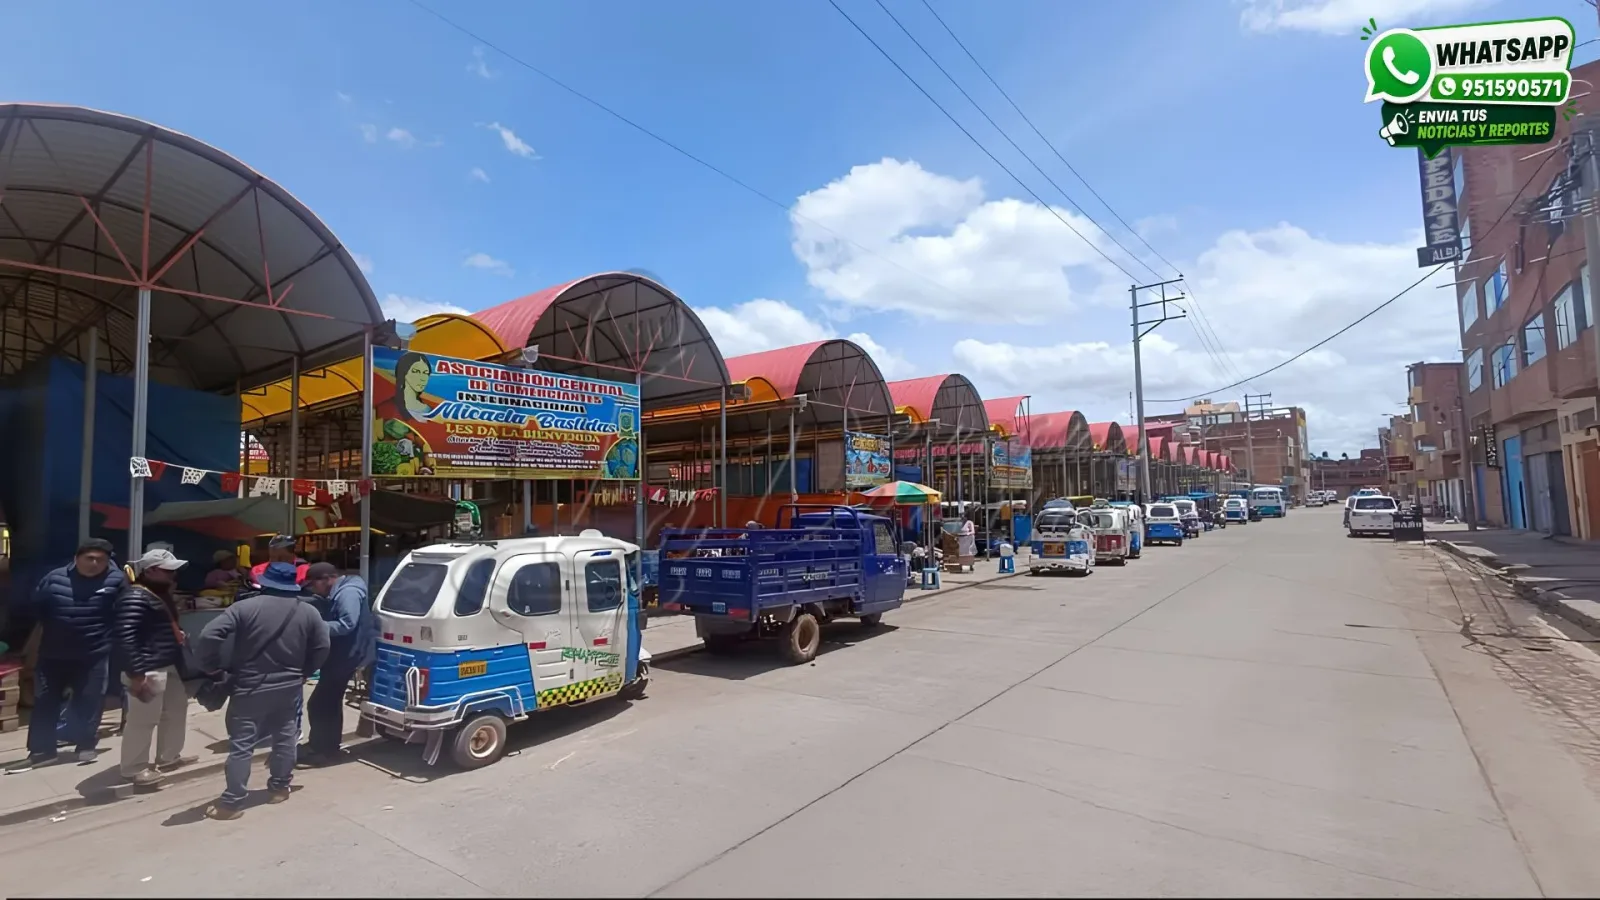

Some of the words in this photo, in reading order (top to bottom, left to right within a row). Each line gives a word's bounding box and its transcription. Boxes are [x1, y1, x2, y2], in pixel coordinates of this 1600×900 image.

[468, 379, 490, 391] DE
[493, 383, 602, 404] COMERCIANTES
[559, 379, 624, 396] CENTRAL
[423, 401, 529, 426] Micaela
[457, 391, 587, 414] INTERNACIONAL
[445, 423, 473, 434] LES
[477, 426, 498, 437] DA
[502, 428, 518, 437] LA
[523, 429, 600, 443] BIENVENIDA
